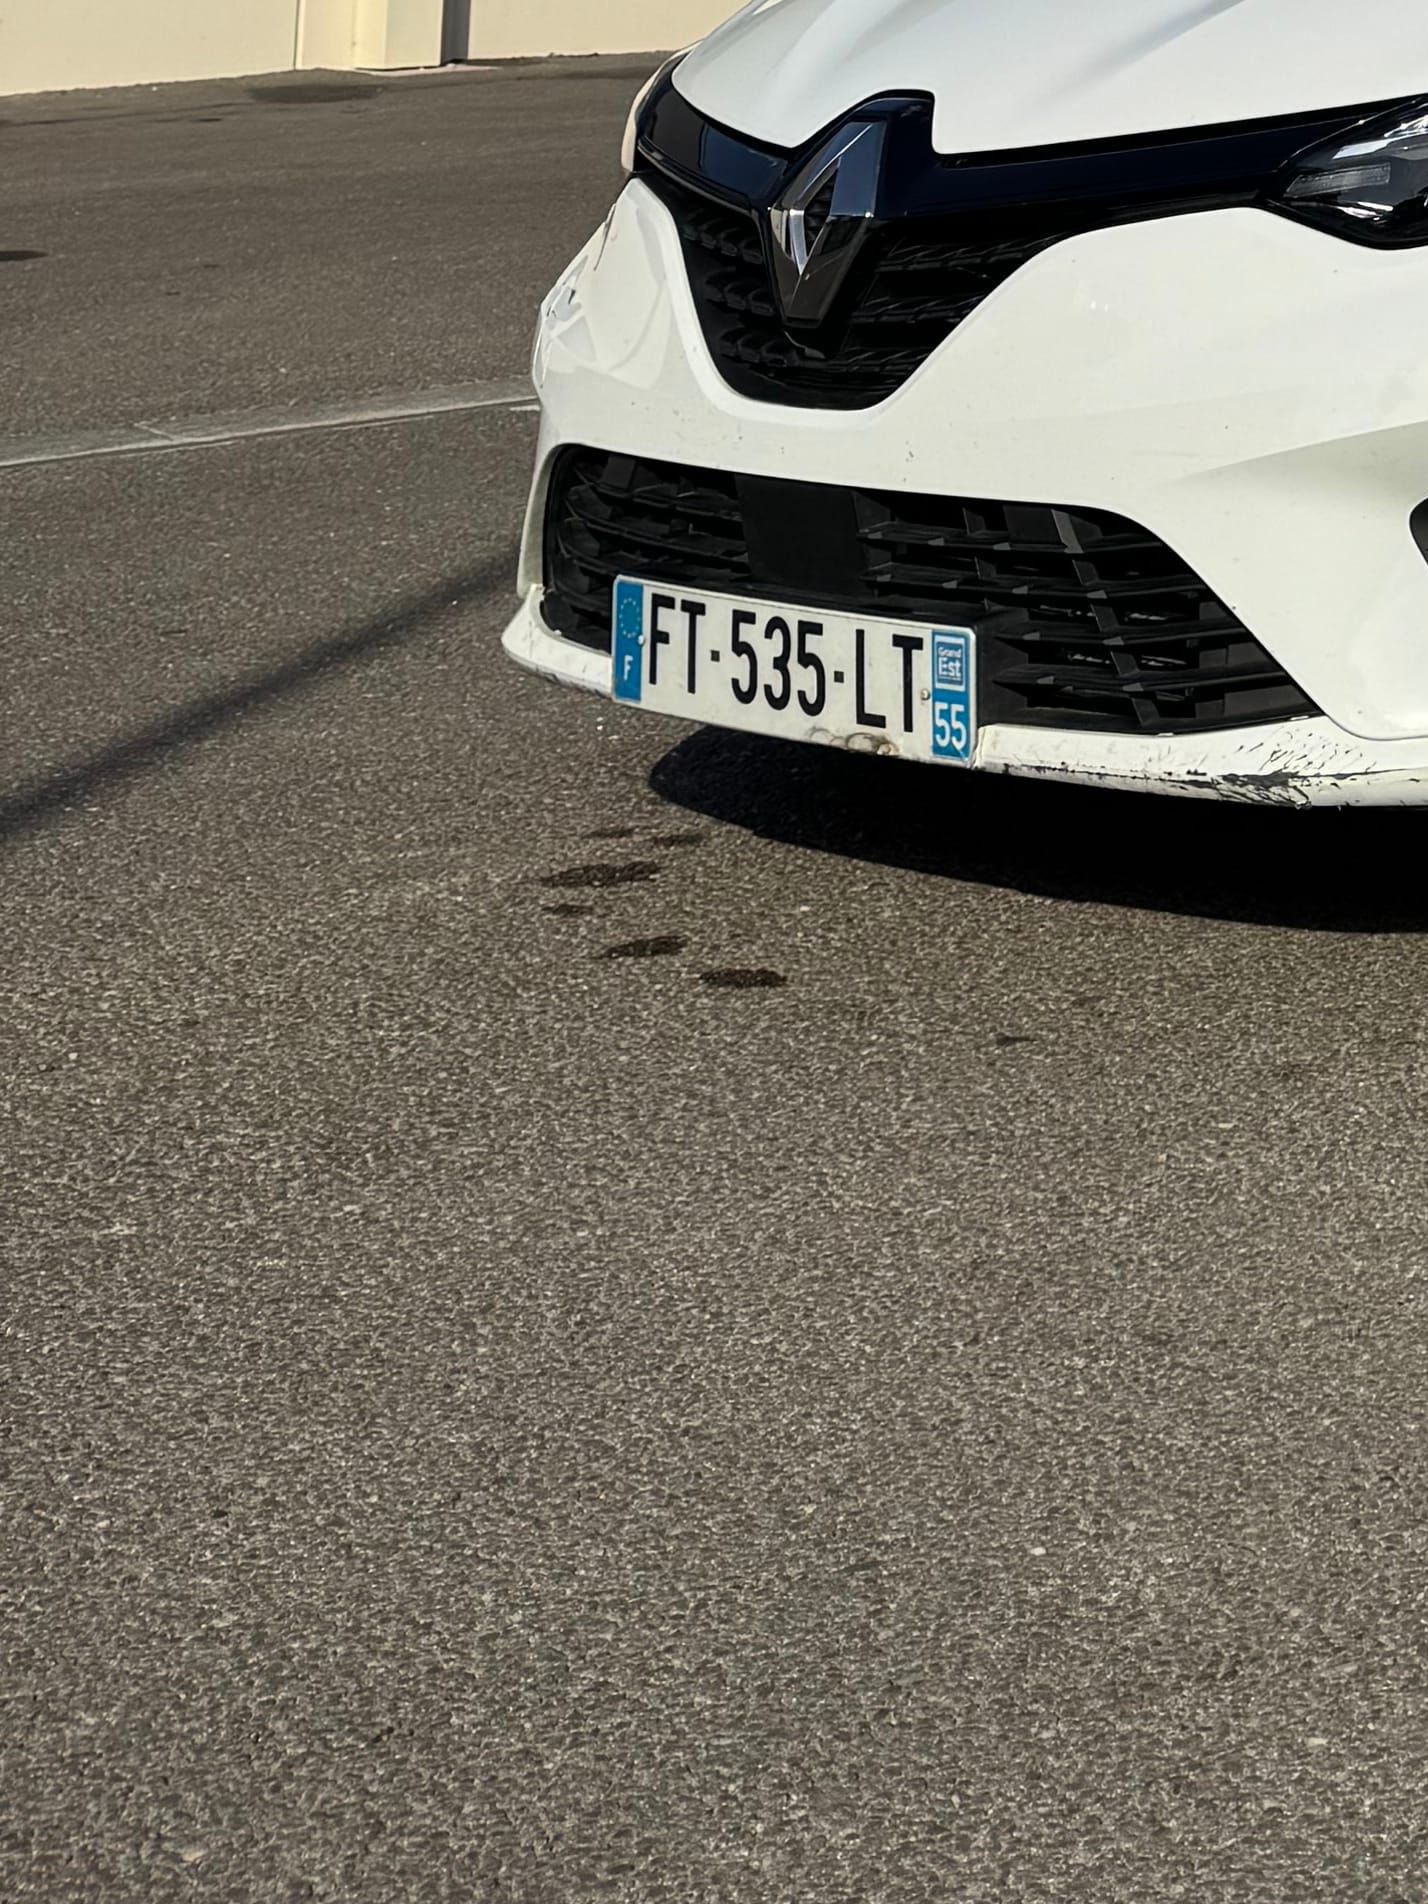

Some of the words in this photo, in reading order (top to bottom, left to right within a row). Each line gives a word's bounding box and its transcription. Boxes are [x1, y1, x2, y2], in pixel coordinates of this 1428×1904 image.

[623, 654, 634, 681] F
[649, 592, 924, 733] FT-535-LT
[938, 657, 961, 680] Est
[935, 700, 967, 750] 55
